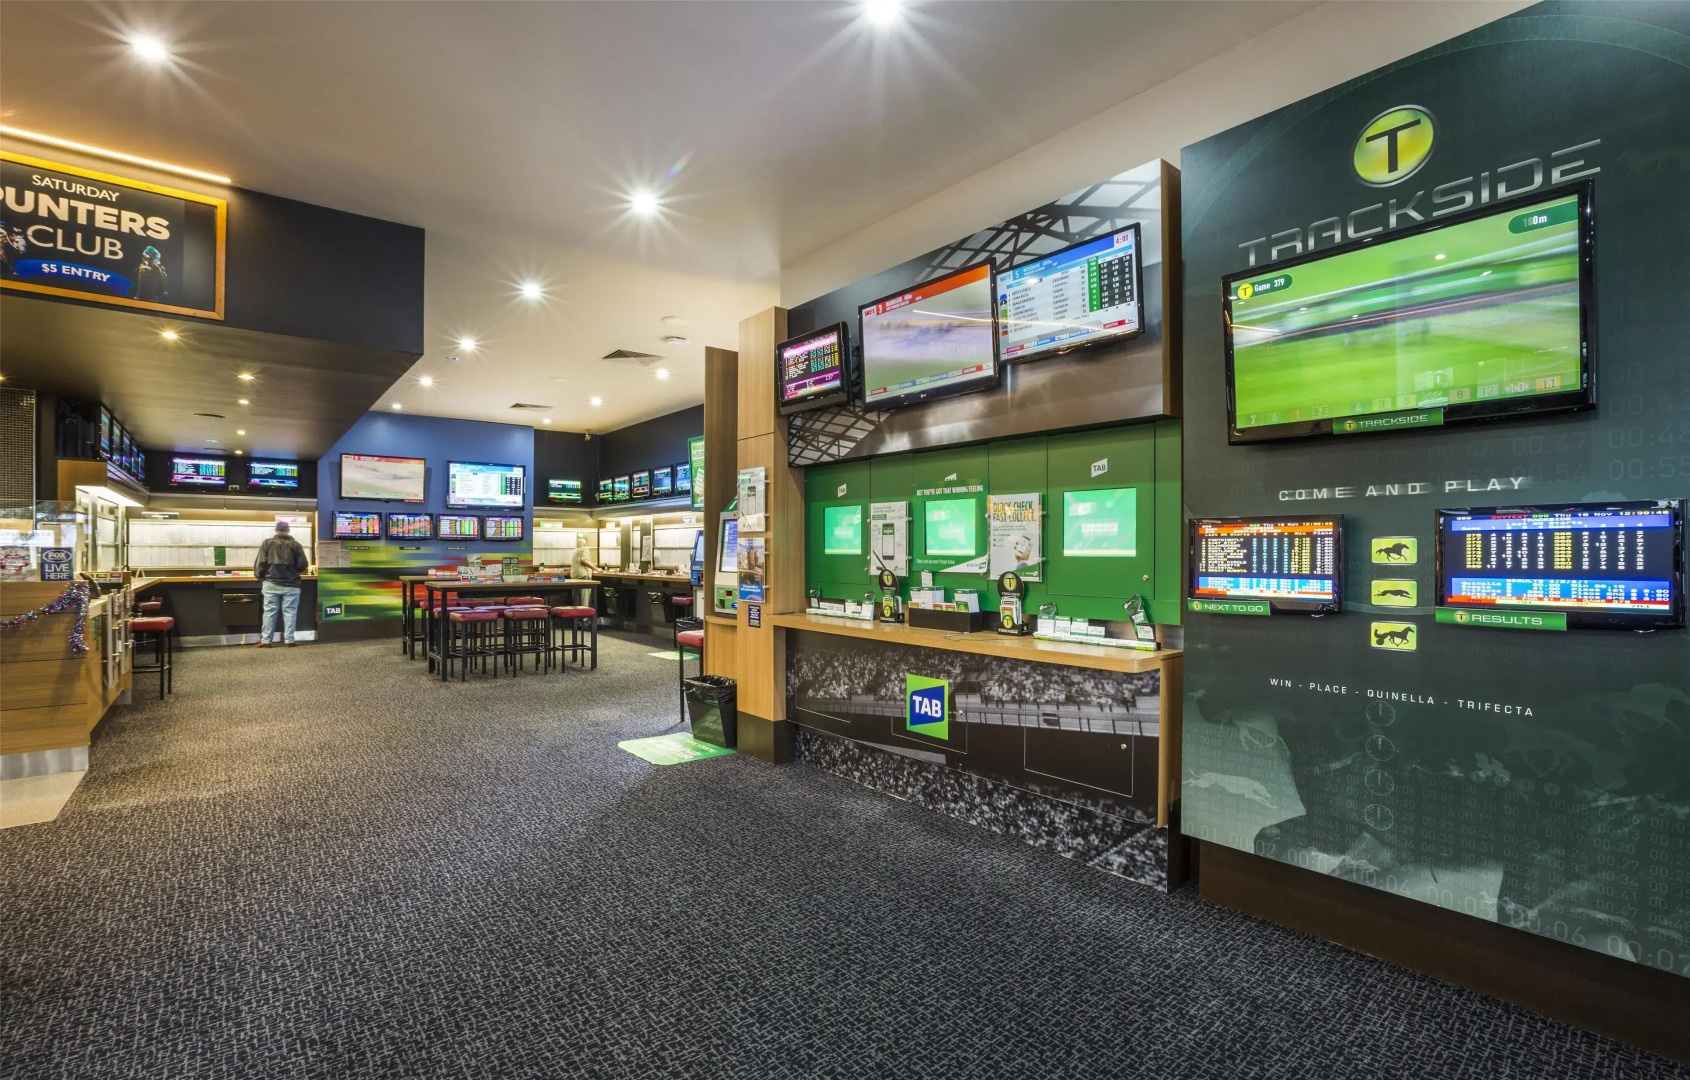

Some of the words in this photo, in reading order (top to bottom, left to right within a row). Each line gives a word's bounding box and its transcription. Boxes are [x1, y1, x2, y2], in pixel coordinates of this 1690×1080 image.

[32, 174, 120, 202] SATURDAY
[0, 186, 171, 240] UNTERS
[1239, 138, 1601, 267] TRACKSIDE
[26, 225, 124, 260] CLUB
[41, 263, 58, 274] $5
[61, 266, 111, 282] ENTRY
[1254, 283, 1271, 292] Game
[1274, 278, 1285, 287] 379
[1358, 415, 1428, 427] TRACKSIDE
[1093, 464, 1106, 472] TAB
[1279, 487, 1345, 501] COME
[1366, 483, 1420, 497] AND
[1445, 478, 1525, 493] PLAY
[45, 563, 69, 572] LIVE
[1204, 604, 1230, 612] NEXT
[1247, 605, 1264, 613] GO
[1472, 614, 1542, 626] RESULTS
[912, 695, 942, 718] TAB
[1270, 678, 1292, 688] WIN
[1309, 682, 1348, 695] PLACE
[1367, 689, 1435, 705] QUINELLA
[1458, 699, 1534, 717] TRIFECTA
